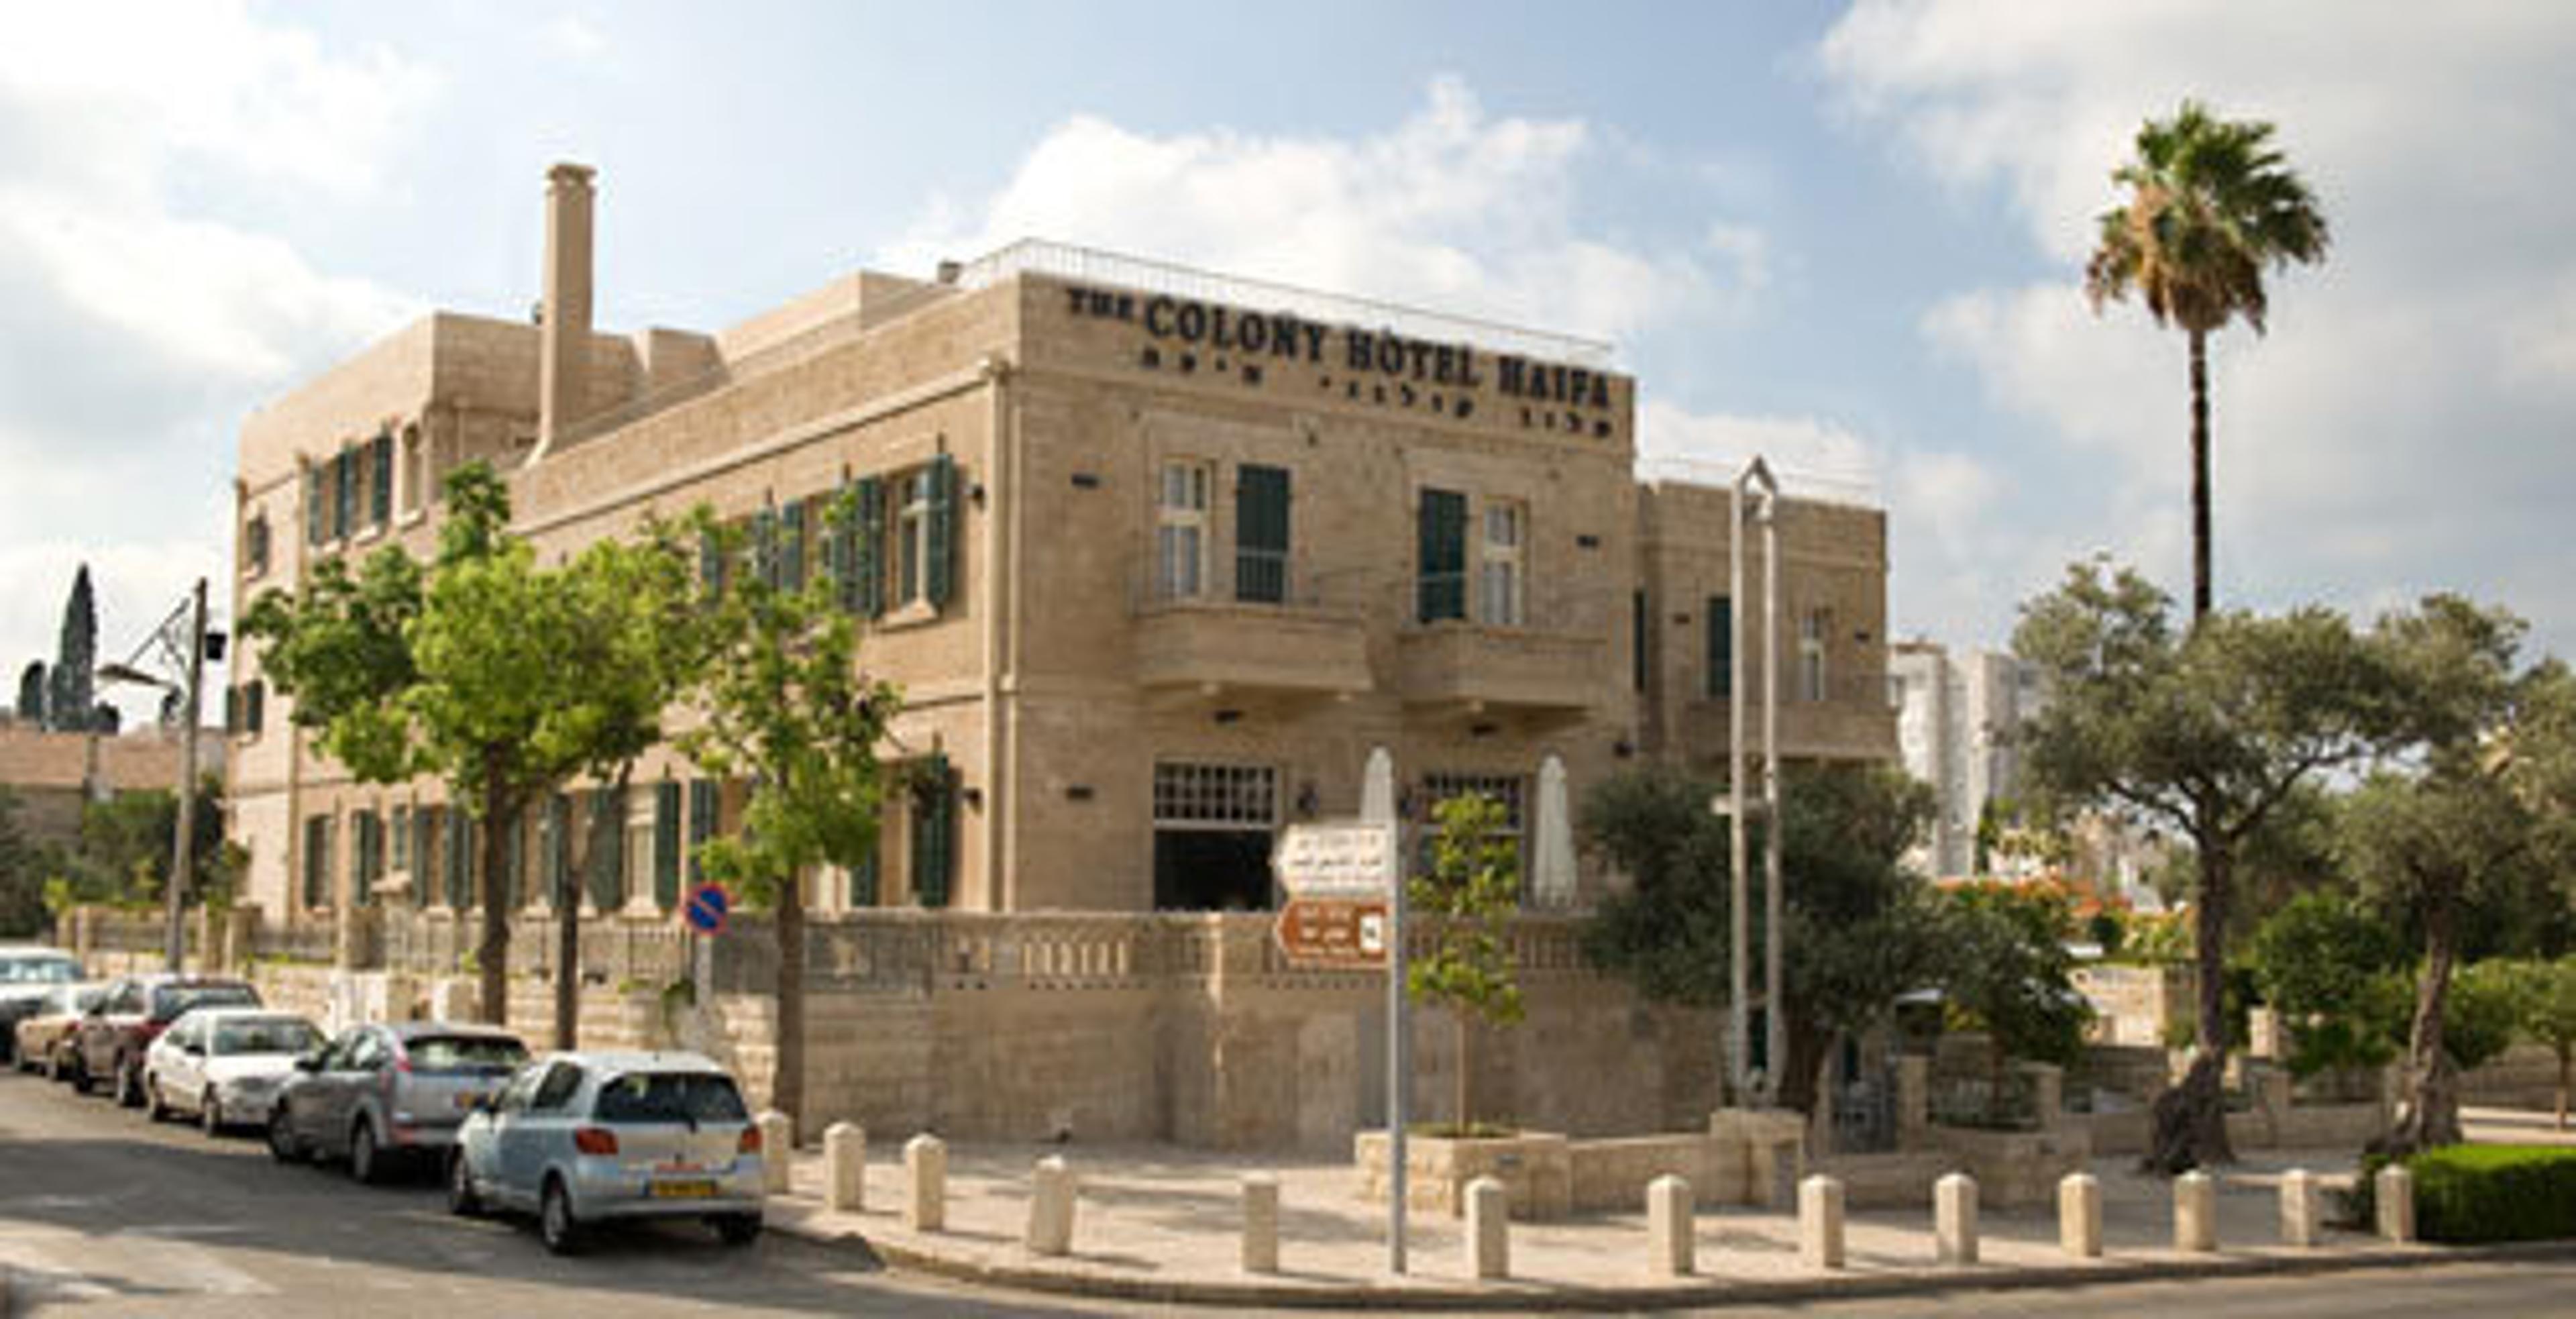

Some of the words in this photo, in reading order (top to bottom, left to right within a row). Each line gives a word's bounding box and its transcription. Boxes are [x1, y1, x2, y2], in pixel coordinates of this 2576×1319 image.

[1067, 287, 1133, 319] THE
[1147, 295, 1328, 363] COLONY
[1347, 328, 1481, 386] HOTEL
[1497, 354, 1608, 408] HAIFA
